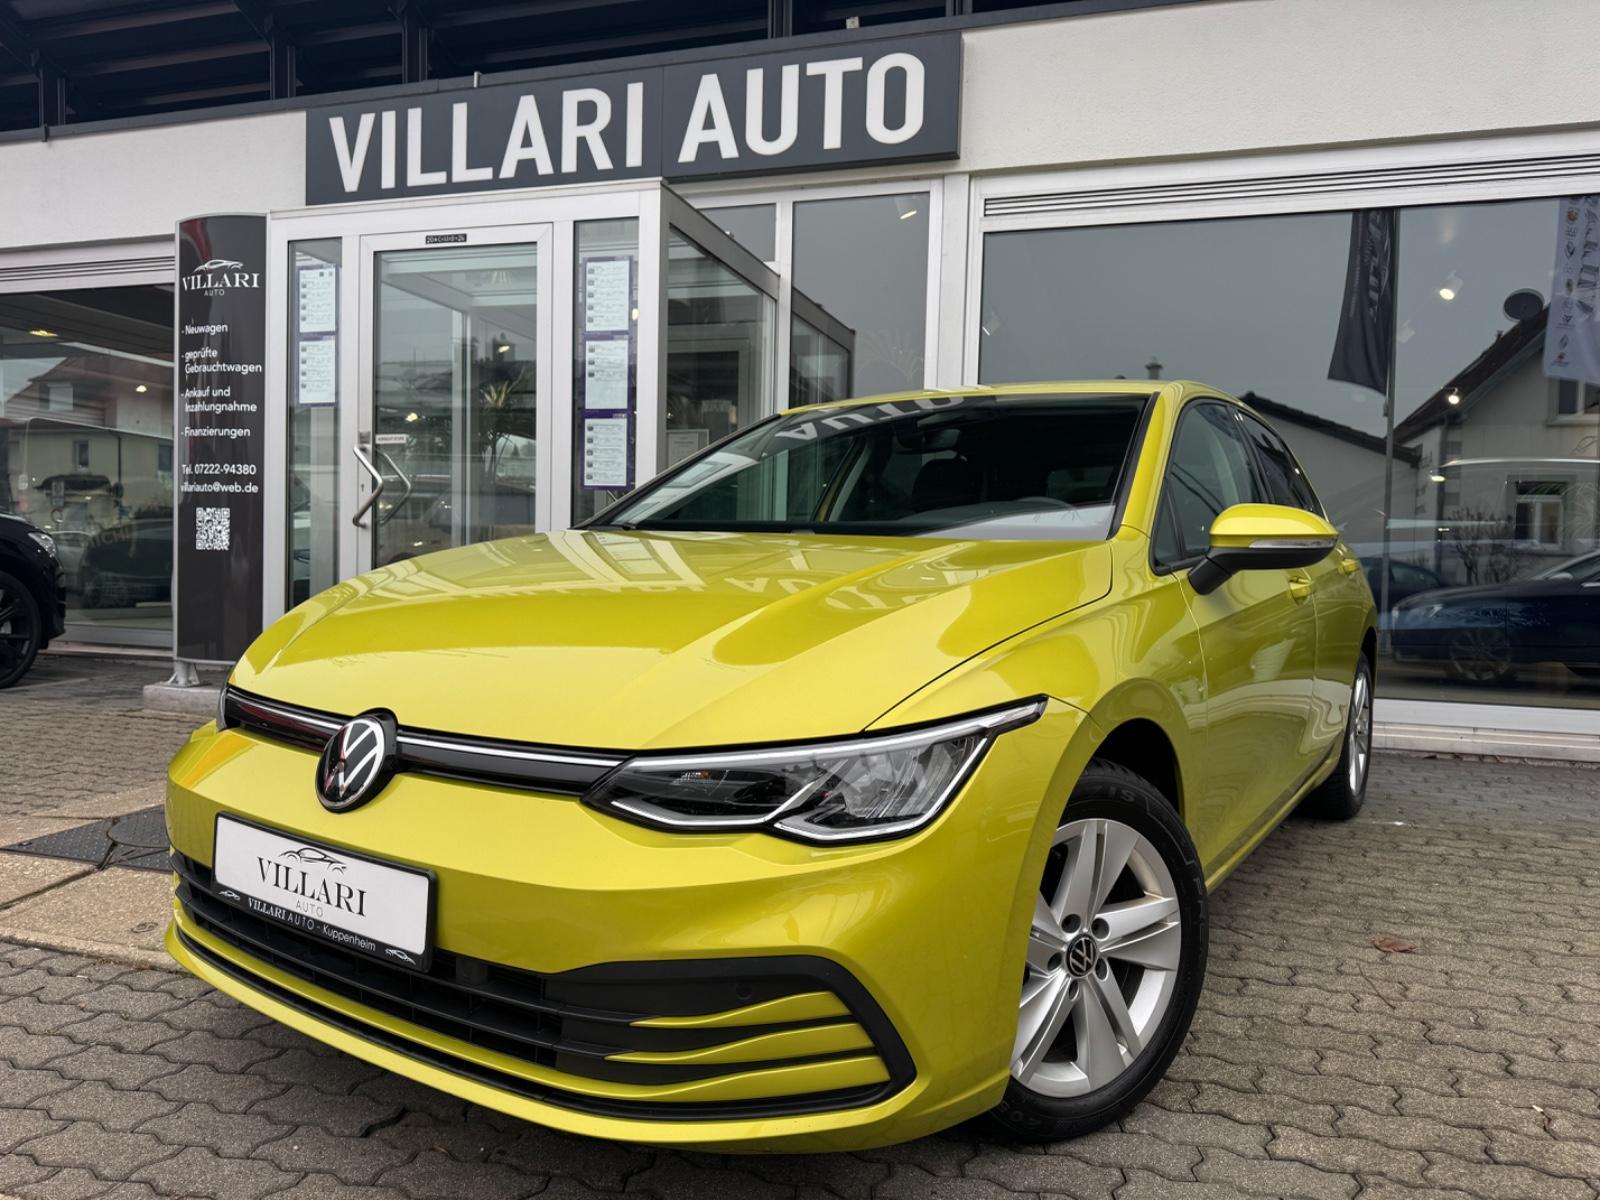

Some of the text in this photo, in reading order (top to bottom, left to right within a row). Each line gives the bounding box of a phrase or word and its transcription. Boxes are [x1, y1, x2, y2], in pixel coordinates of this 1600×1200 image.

[329, 53, 926, 193] VILLARI AUTO
[182, 272, 260, 291] VILLARI
[204, 289, 225, 297] AUTO
[185, 323, 228, 335] Neuwagen
[185, 347, 218, 363] geprüfte
[185, 361, 262, 375] Gebrauchtwagen
[185, 386, 231, 398] Ankauf und
[185, 401, 258, 414] Inzahlungnahme
[184, 426, 251, 439] Finanzierungen
[182, 464, 257, 475] Tel. 07222-94380
[181, 482, 259, 493] villariauto@web.de
[256, 856, 368, 918] VILLARI
[295, 899, 324, 918] AUTO
[248, 897, 287, 921] VILLARI
[287, 912, 315, 931] AUTO
[322, 924, 376, 952] Kuppenheim
